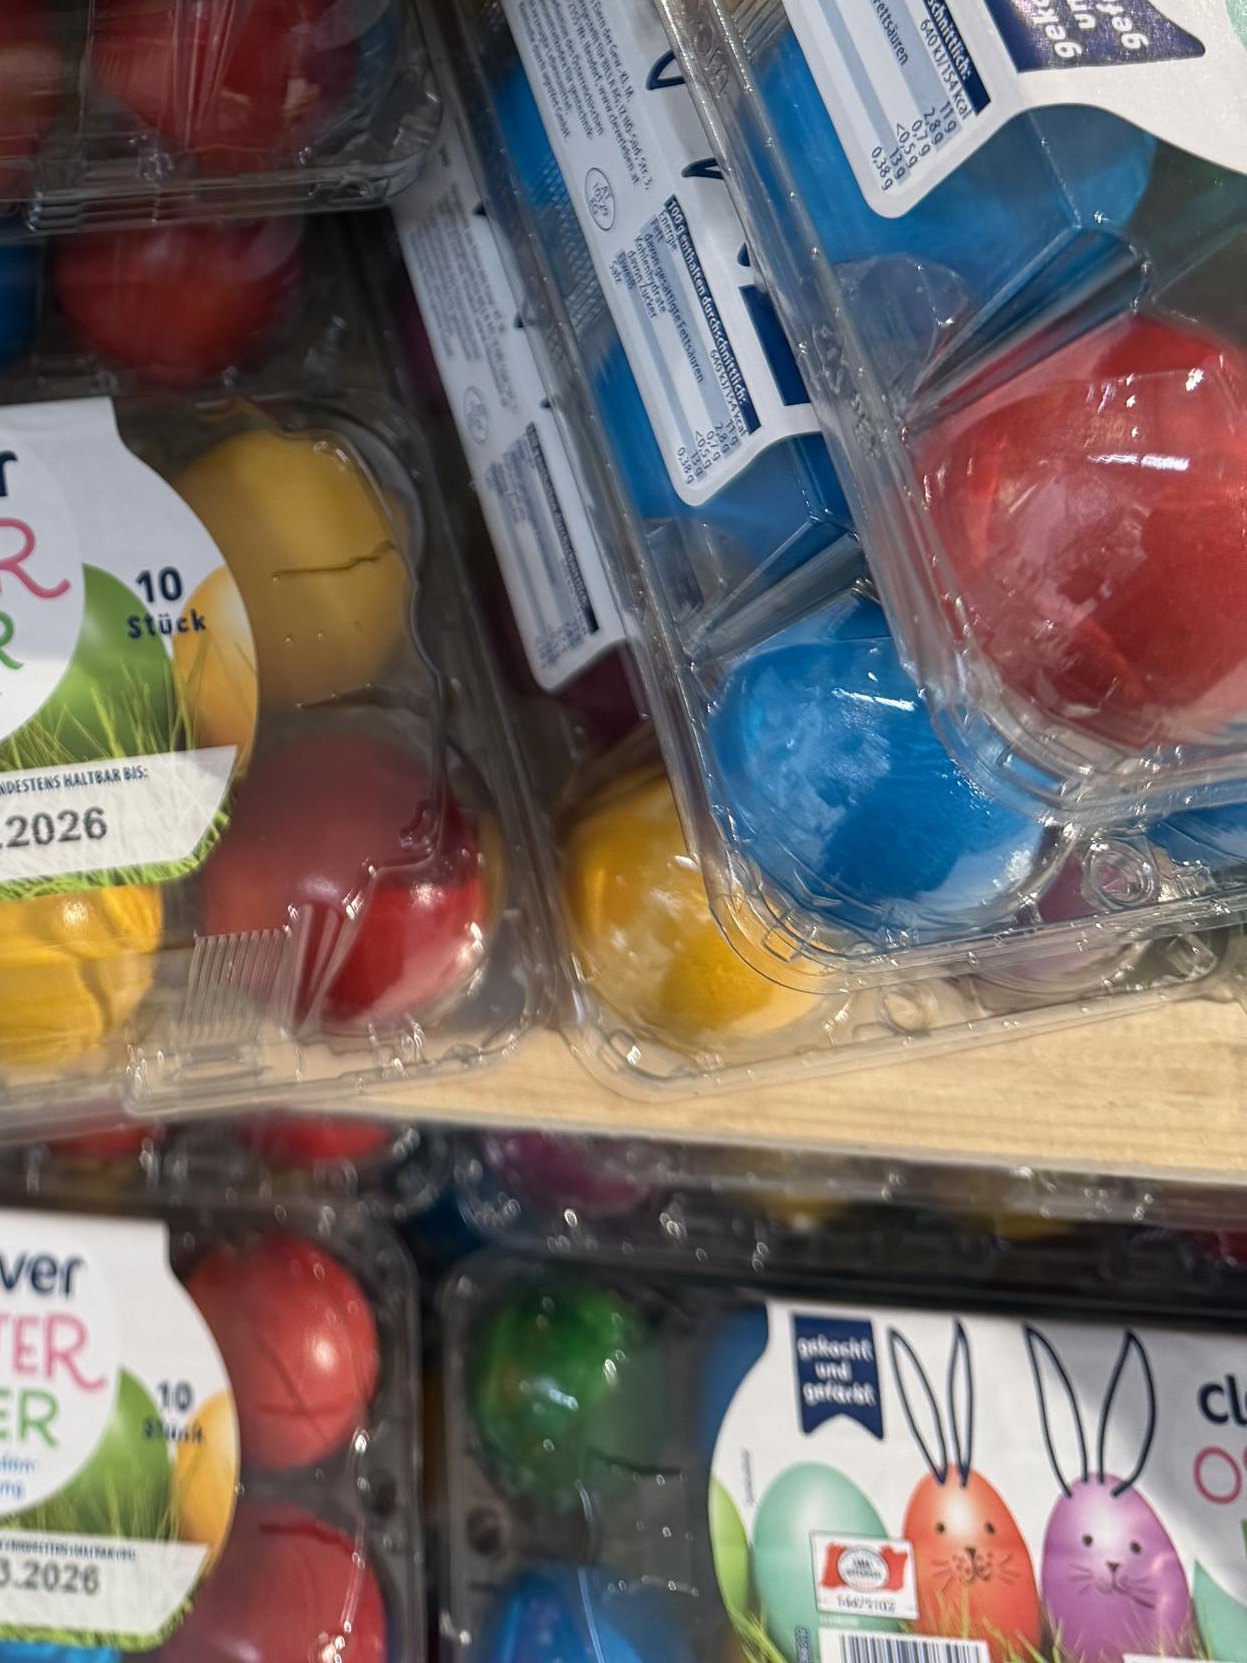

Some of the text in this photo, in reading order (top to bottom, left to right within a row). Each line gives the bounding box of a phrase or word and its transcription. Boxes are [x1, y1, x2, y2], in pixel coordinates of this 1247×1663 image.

[919, 13, 938, 51] 640
[951, 83, 972, 123] kcal
[892, 115, 915, 160] <0,5
[909, 114, 928, 149] 0,7
[921, 101, 941, 139] 2,8
[870, 142, 891, 182] 0,38
[135, 565, 184, 604] 10
[127, 610, 207, 639] Stück
[62, 770, 122, 789] HALTBAR
[123, 766, 149, 782] BIS:
[816, 1361, 851, 1382] und
[157, 1380, 193, 1411] 10
